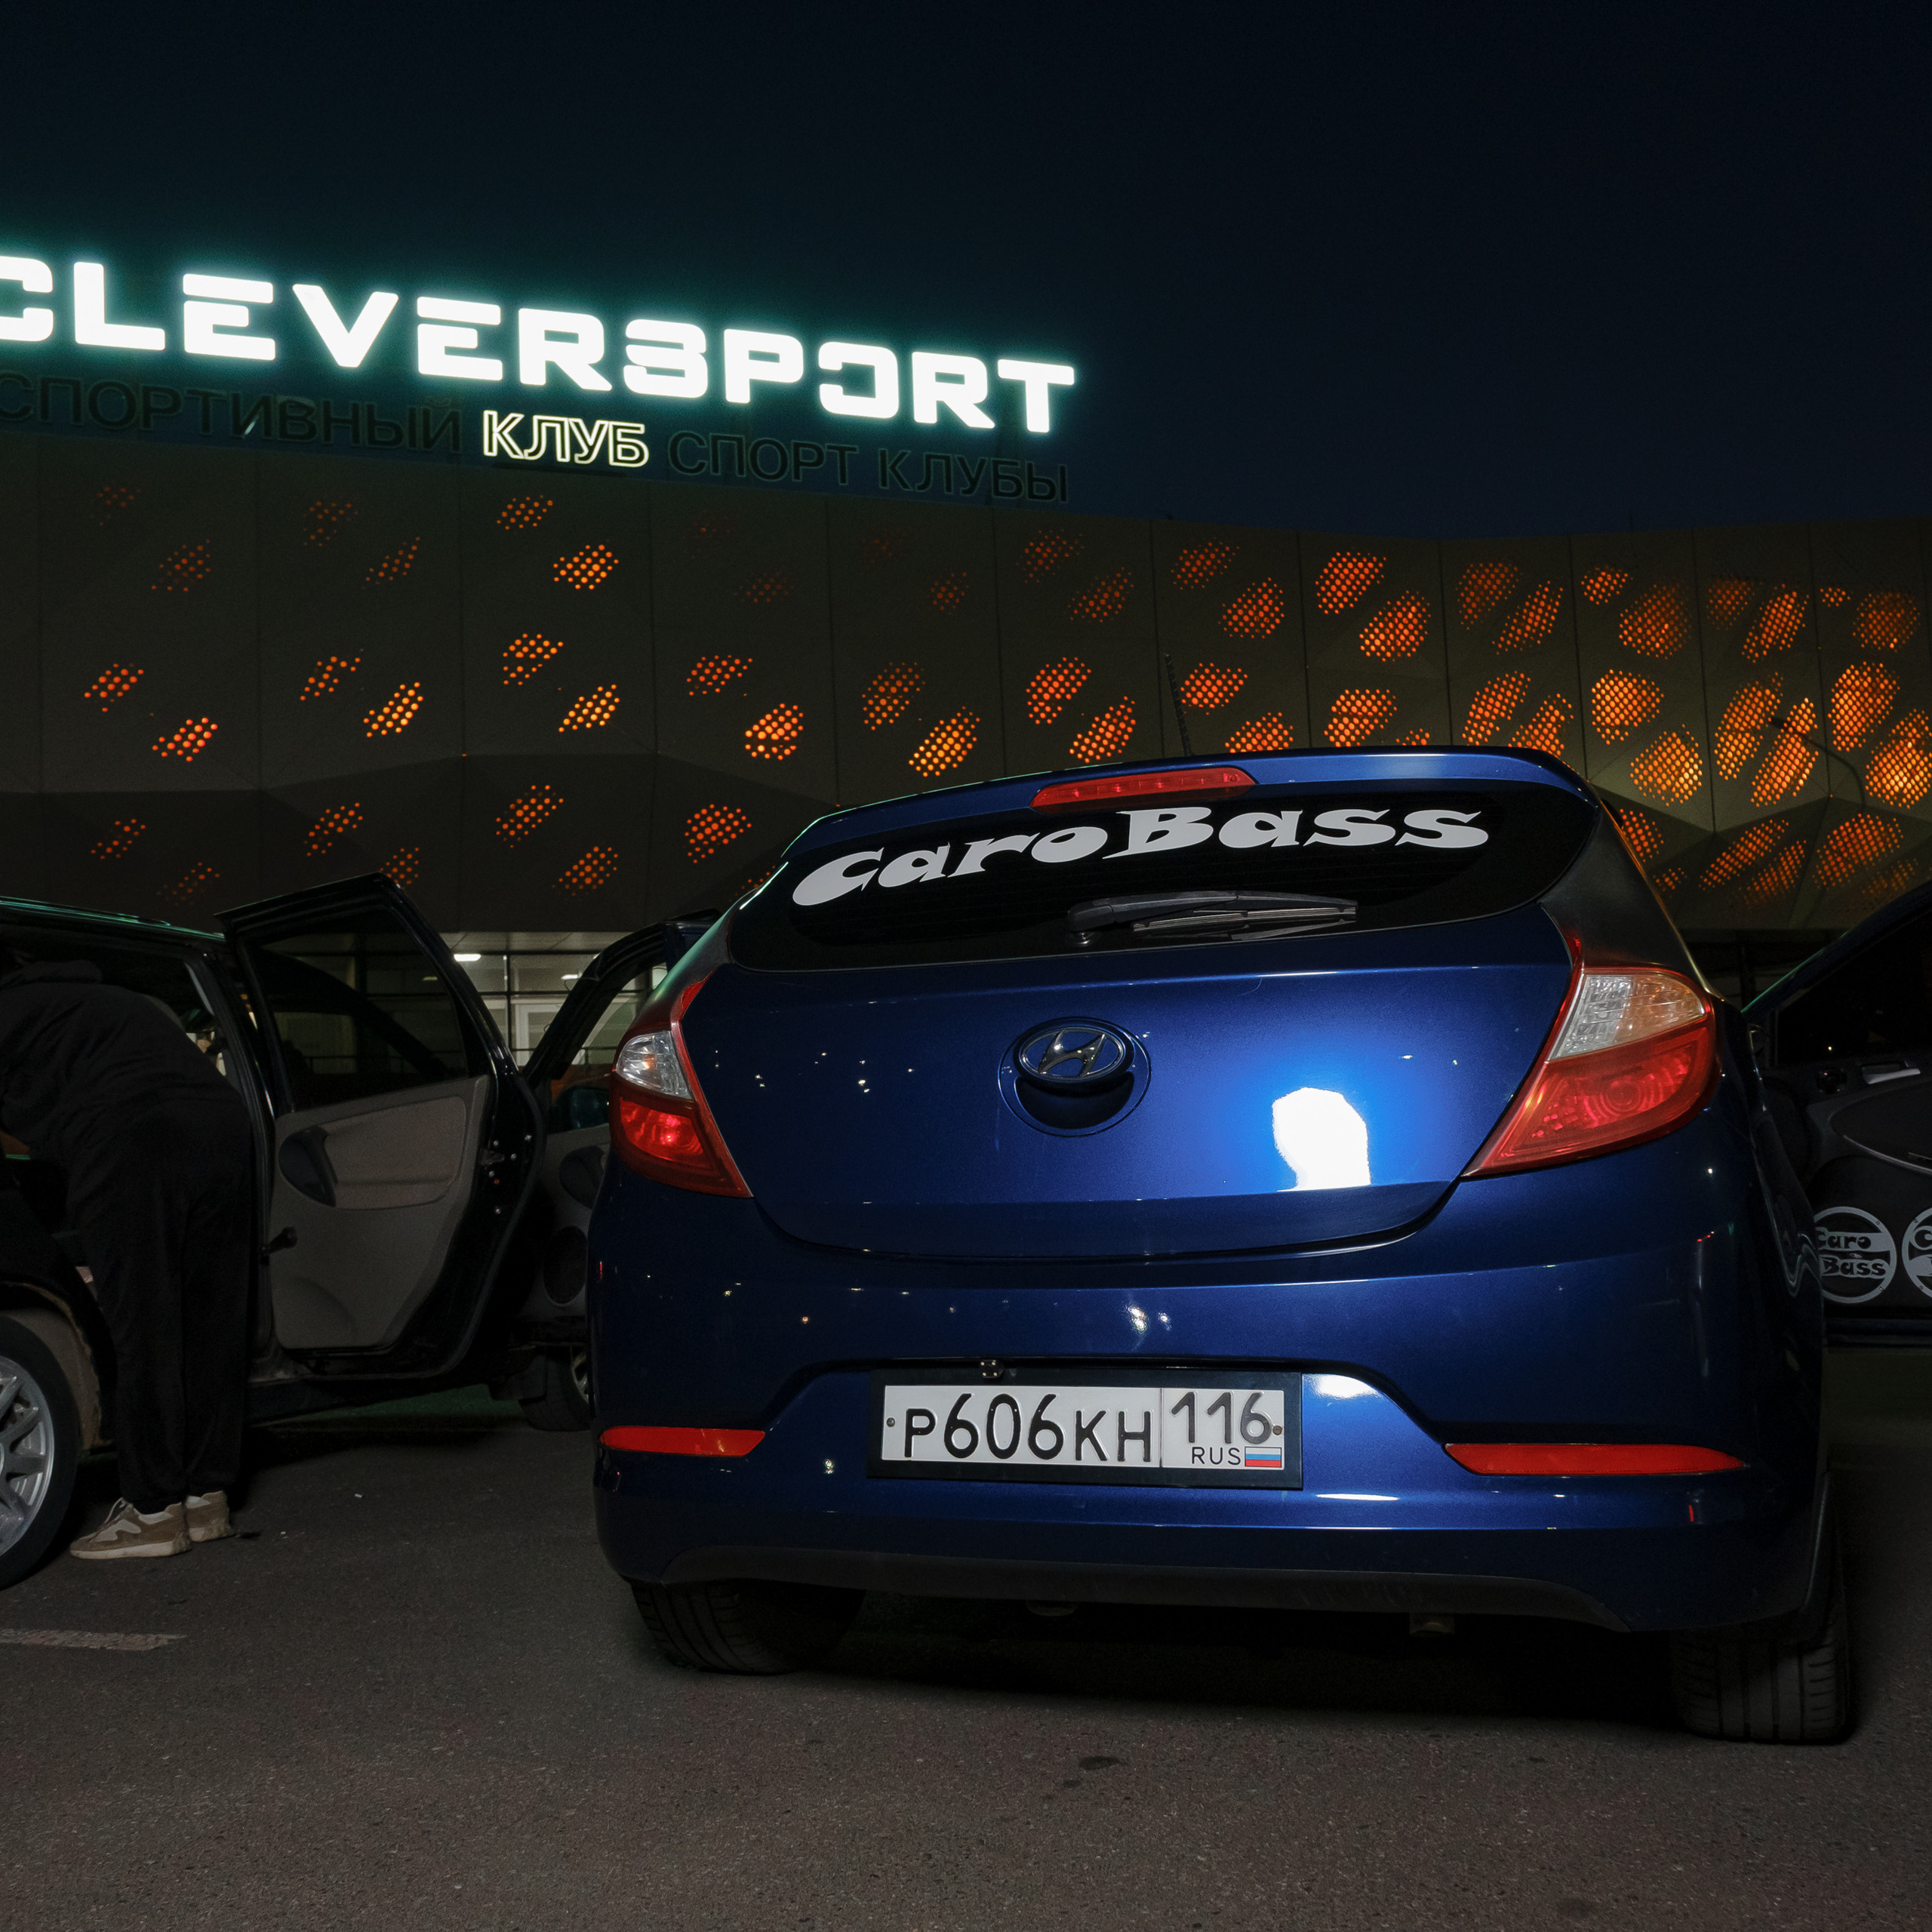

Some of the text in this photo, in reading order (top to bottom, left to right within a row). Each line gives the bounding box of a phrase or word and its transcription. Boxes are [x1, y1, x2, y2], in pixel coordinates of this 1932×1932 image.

[0, 371, 1068, 503] СПОРТИВНЫЙ КЛУБ СПОРТ КЛУБЫ
[1820, 1257, 1886, 1276] Bass
[1171, 1391, 1272, 1445] 116
[1191, 1446, 1241, 1466] RUS
